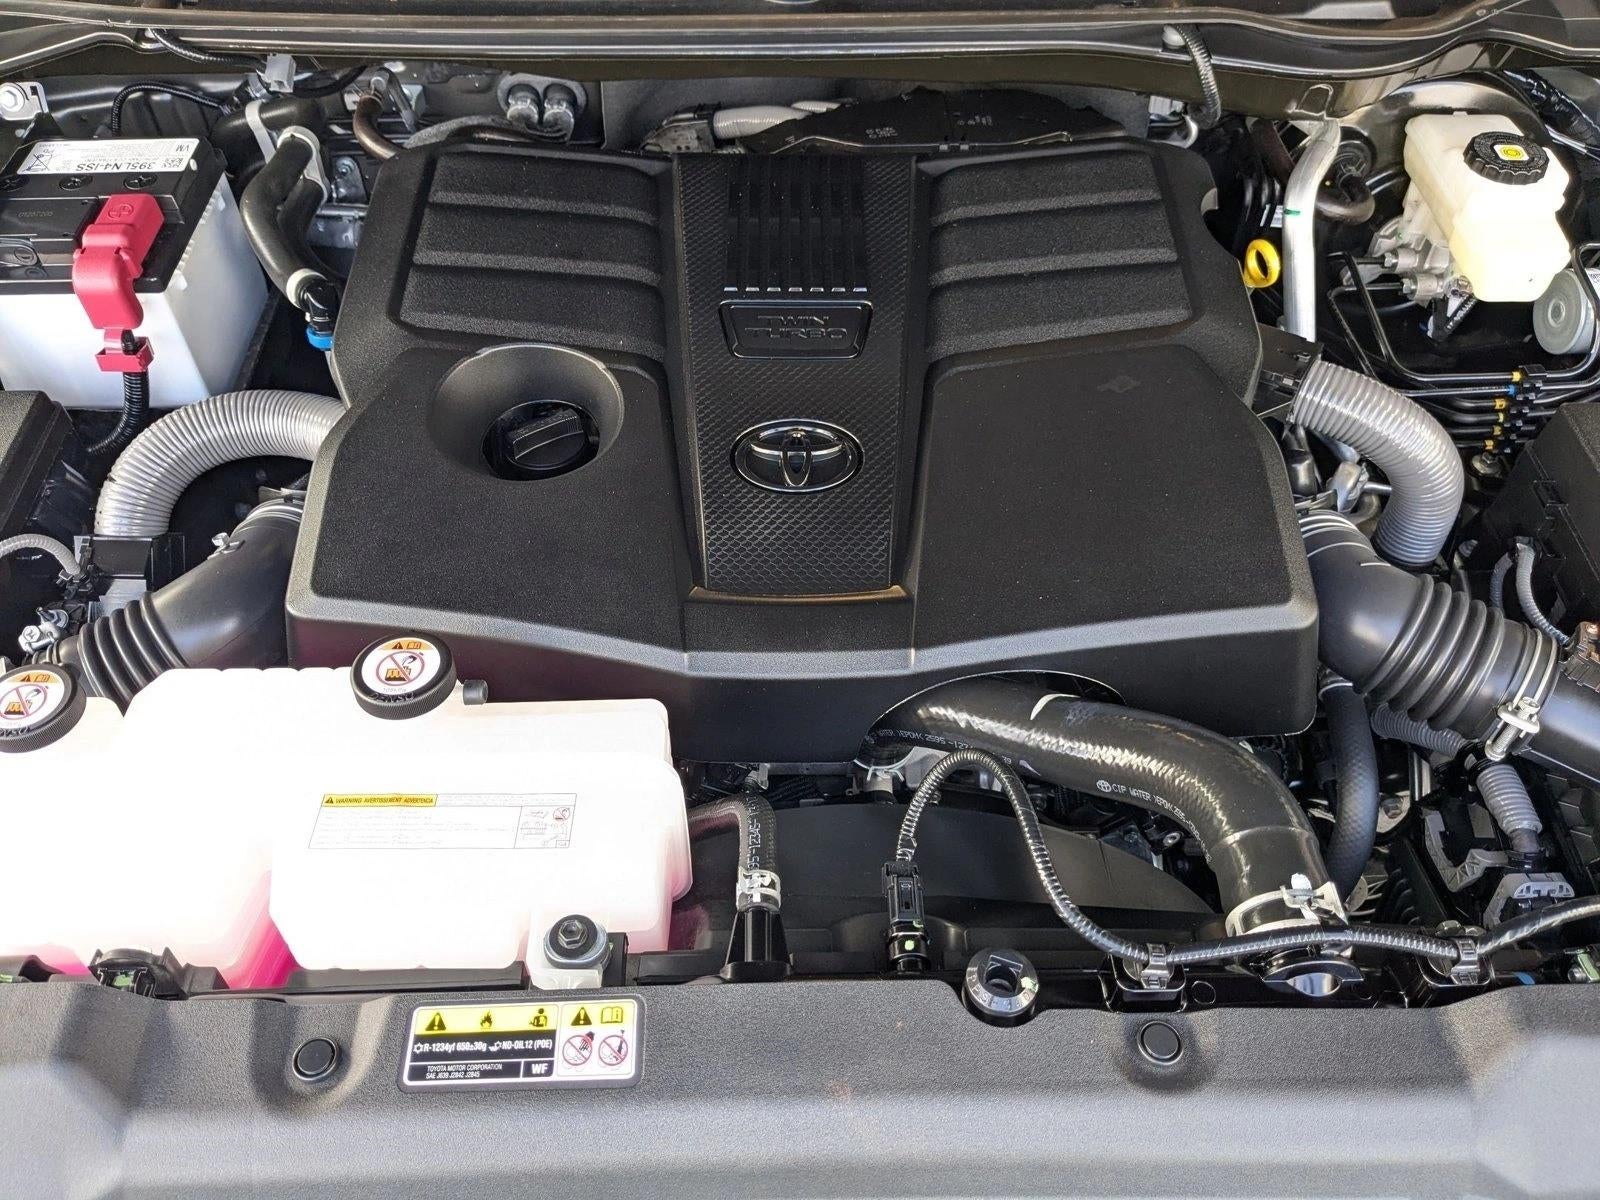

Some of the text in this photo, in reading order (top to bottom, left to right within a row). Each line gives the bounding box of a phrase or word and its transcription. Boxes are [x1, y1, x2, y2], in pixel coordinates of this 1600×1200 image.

[757, 315, 829, 326] TWIN
[745, 327, 848, 339] TURBO
[423, 1043, 456, 1054] R-1234yf
[533, 1038, 553, 1051] (POE)
[427, 1062, 503, 1073] TOYOTA MOTOR CORPORATION
[531, 1063, 549, 1075] WF
[425, 1072, 437, 1080] SAE
